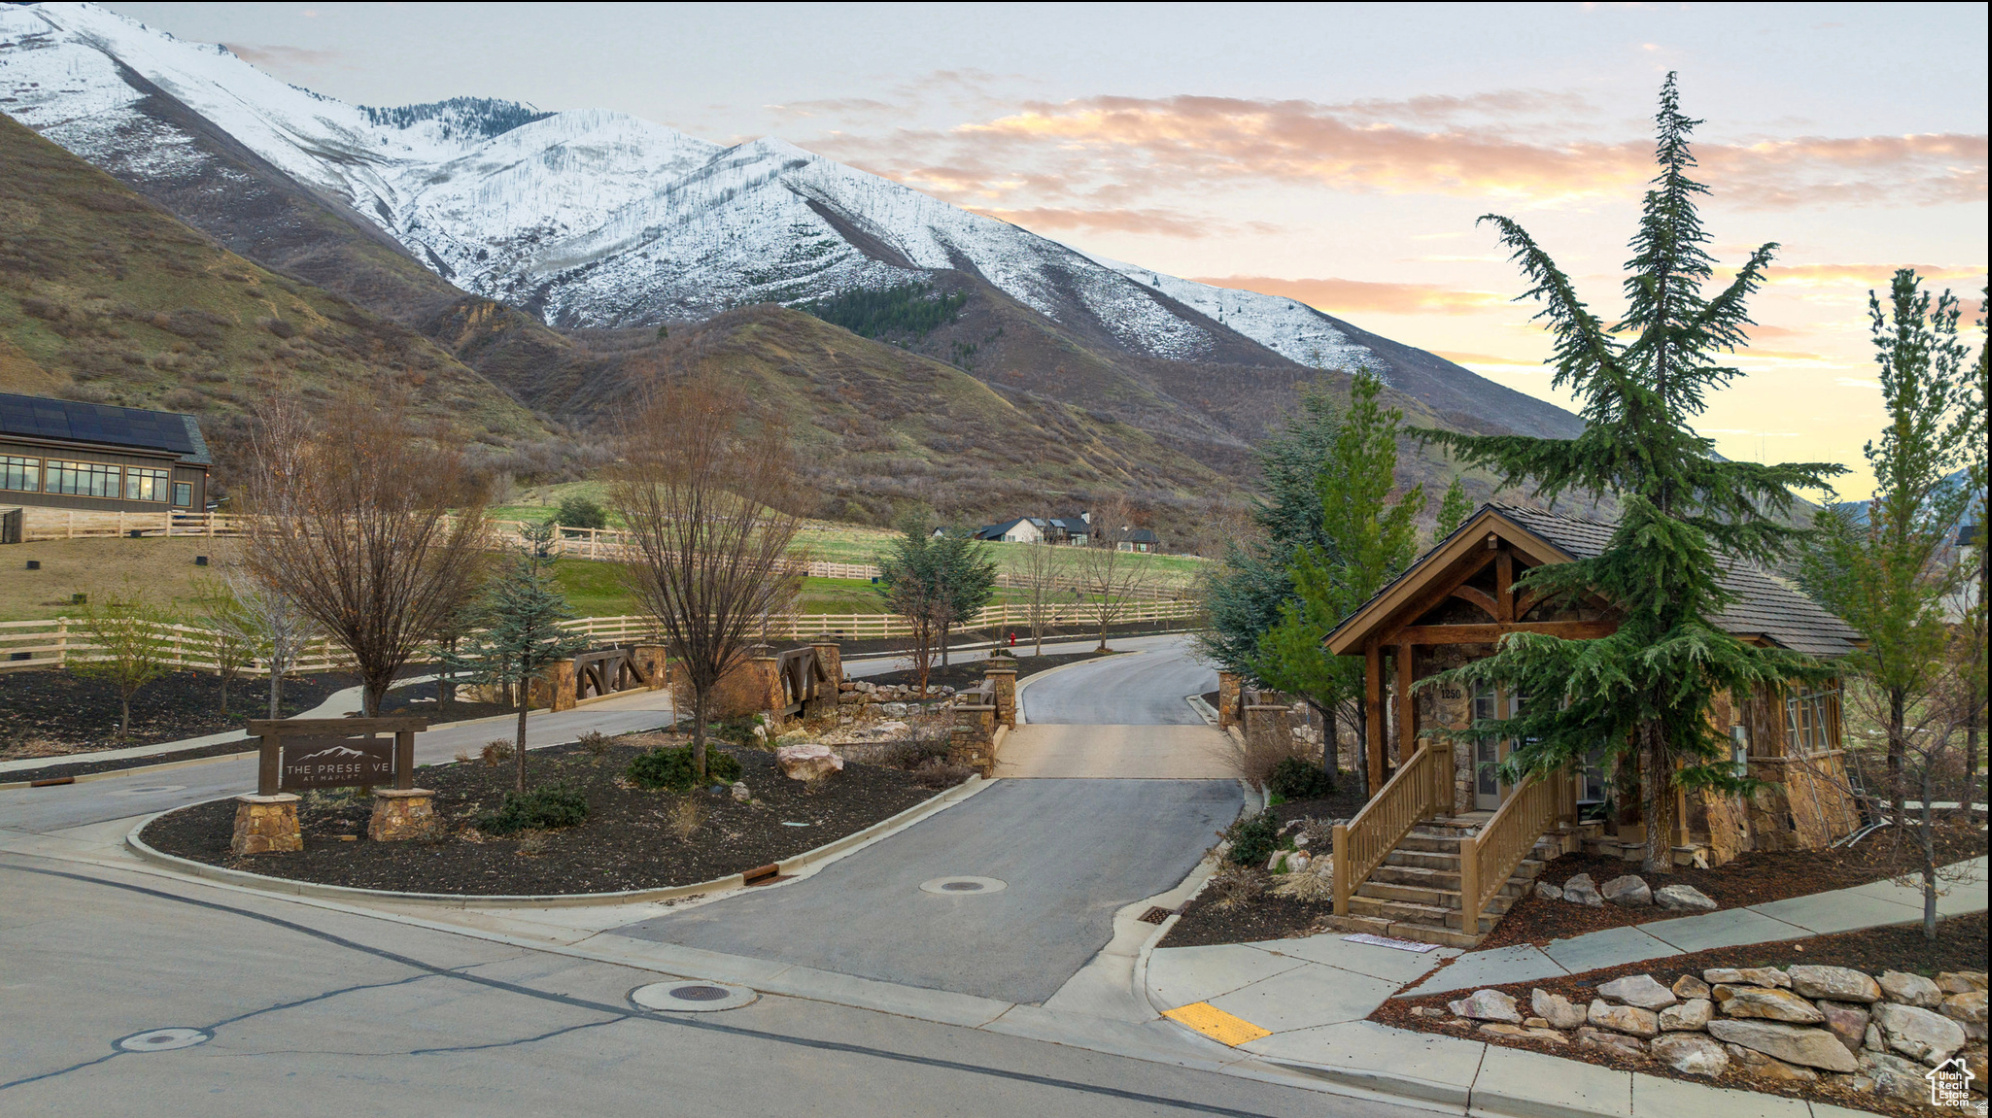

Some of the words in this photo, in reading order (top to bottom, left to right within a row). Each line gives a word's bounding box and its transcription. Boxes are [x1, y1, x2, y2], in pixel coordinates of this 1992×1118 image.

[1441, 689, 1461, 699] 1250
[287, 765, 311, 775] THE
[318, 763, 389, 773] PRESEVE
